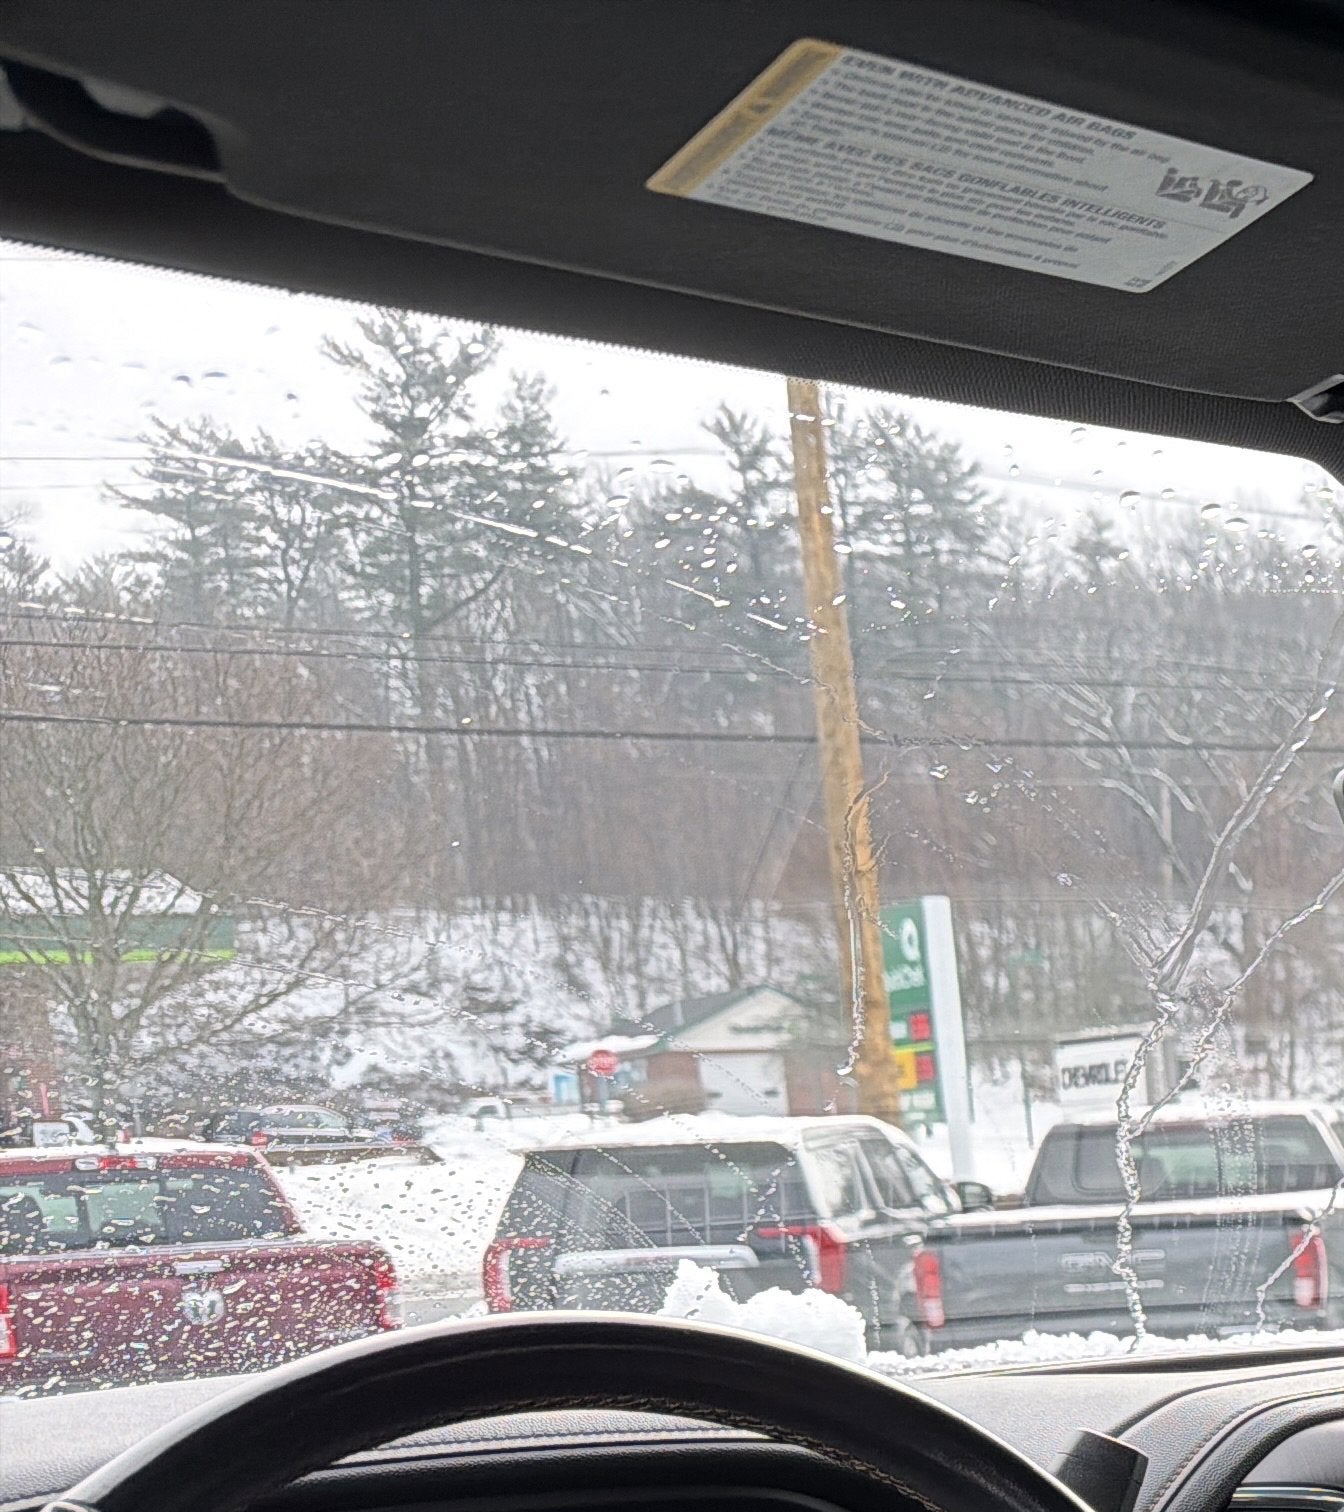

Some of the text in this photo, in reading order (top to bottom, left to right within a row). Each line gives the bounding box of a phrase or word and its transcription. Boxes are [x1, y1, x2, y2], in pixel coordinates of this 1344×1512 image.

[951, 85, 1051, 117] ADVANCED
[1052, 113, 1085, 126] AIR
[1086, 123, 1135, 139] BAGS
[956, 175, 1061, 203] GONFLABLES
[1060, 200, 1167, 228] INTELLIGENTS
